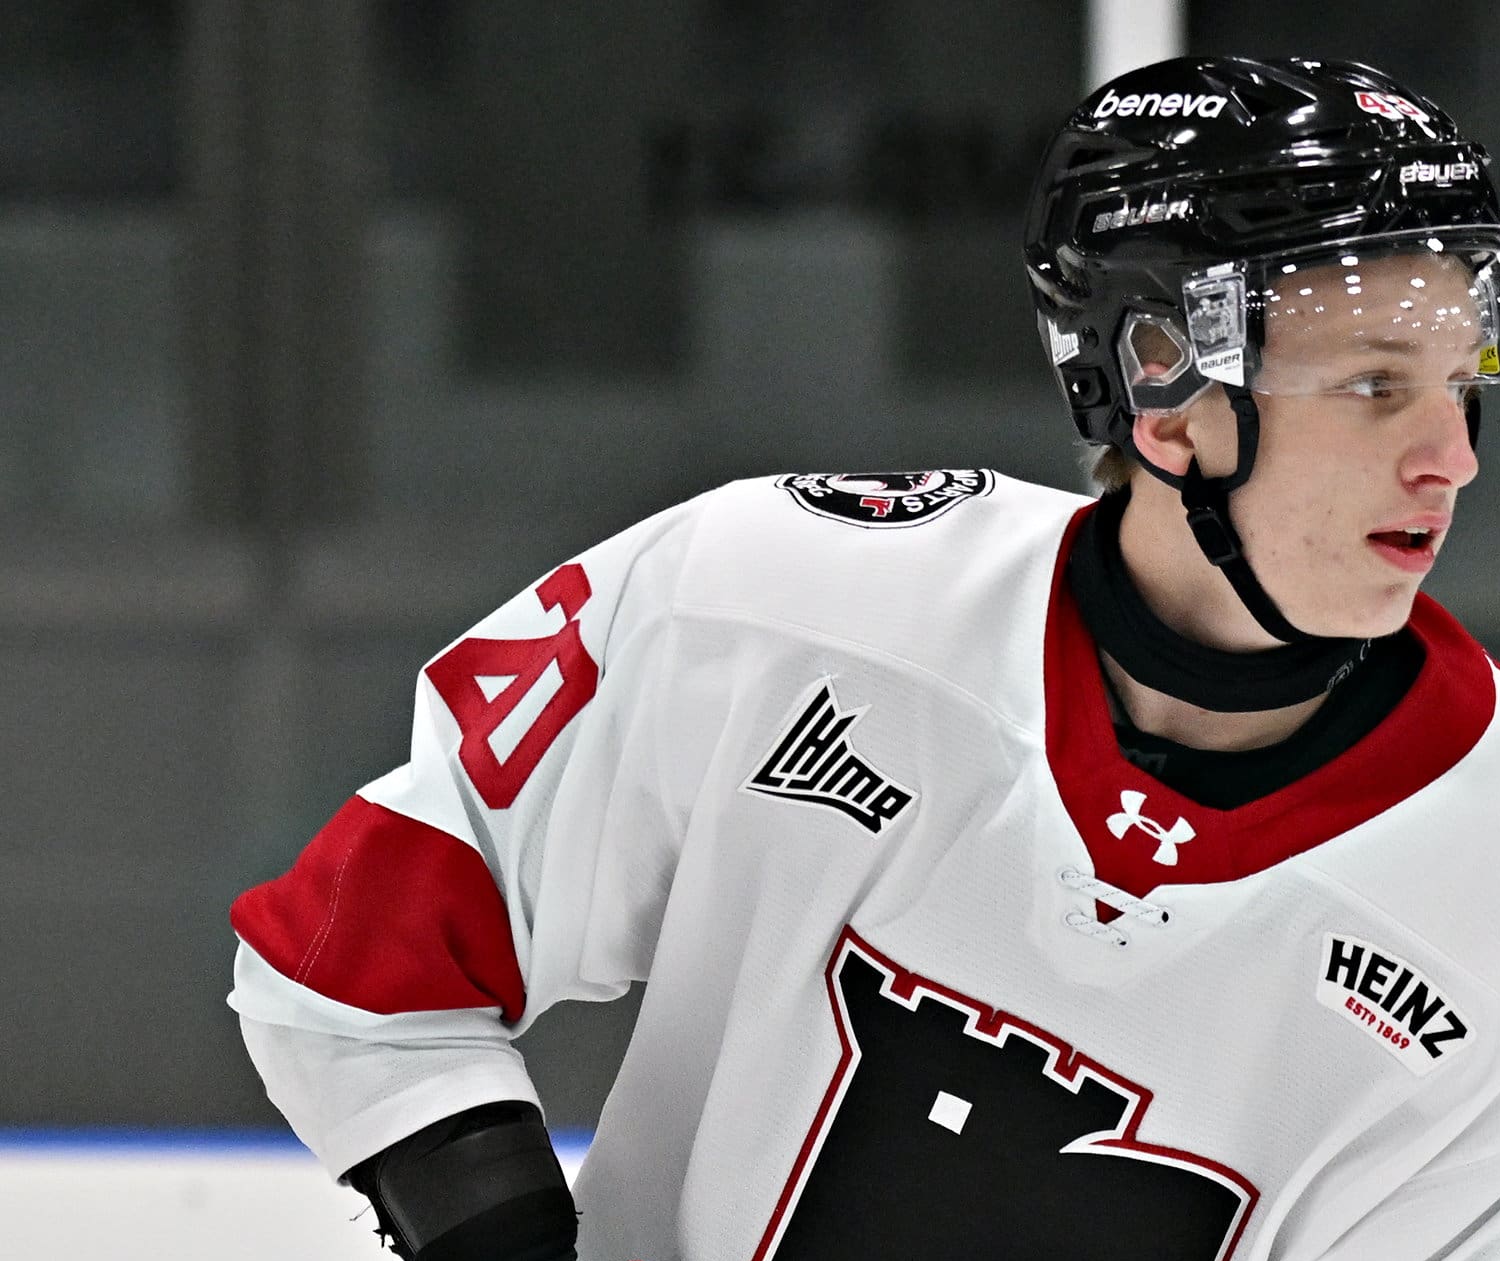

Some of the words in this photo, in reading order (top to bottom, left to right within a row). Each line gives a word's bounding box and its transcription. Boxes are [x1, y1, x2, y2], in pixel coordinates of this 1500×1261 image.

[1092, 88, 1228, 118] beneva
[1325, 938, 1468, 1060] HEINZ
[1376, 1020, 1411, 1050] 1869
